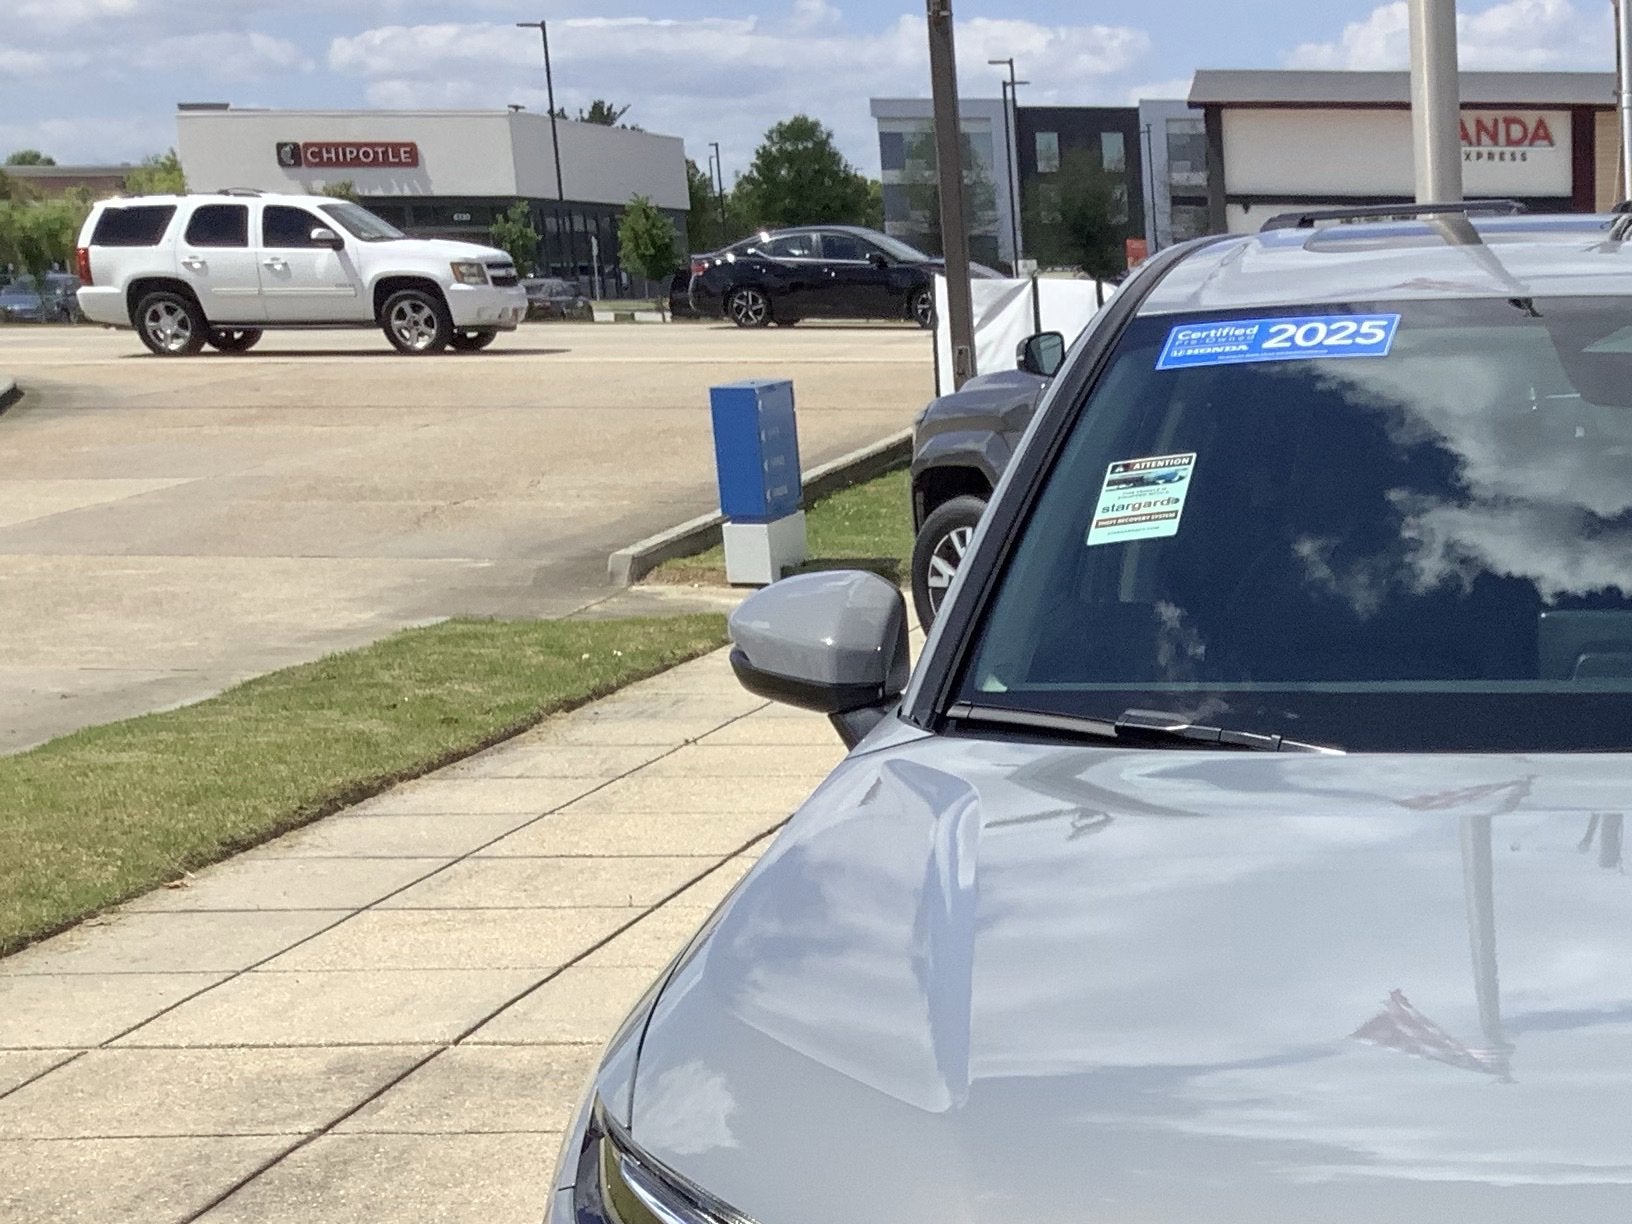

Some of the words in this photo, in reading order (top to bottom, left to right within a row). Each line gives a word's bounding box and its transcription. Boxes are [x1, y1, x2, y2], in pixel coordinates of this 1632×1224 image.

[1459, 116, 1555, 147] ANDA
[306, 146, 413, 163] CHIPOTLE
[1464, 151, 1529, 162] XPRESS
[1177, 324, 1260, 341] Certified
[1261, 319, 1389, 349] 2025
[1185, 344, 1250, 356] HONDA
[1132, 457, 1190, 470] ATTENTION
